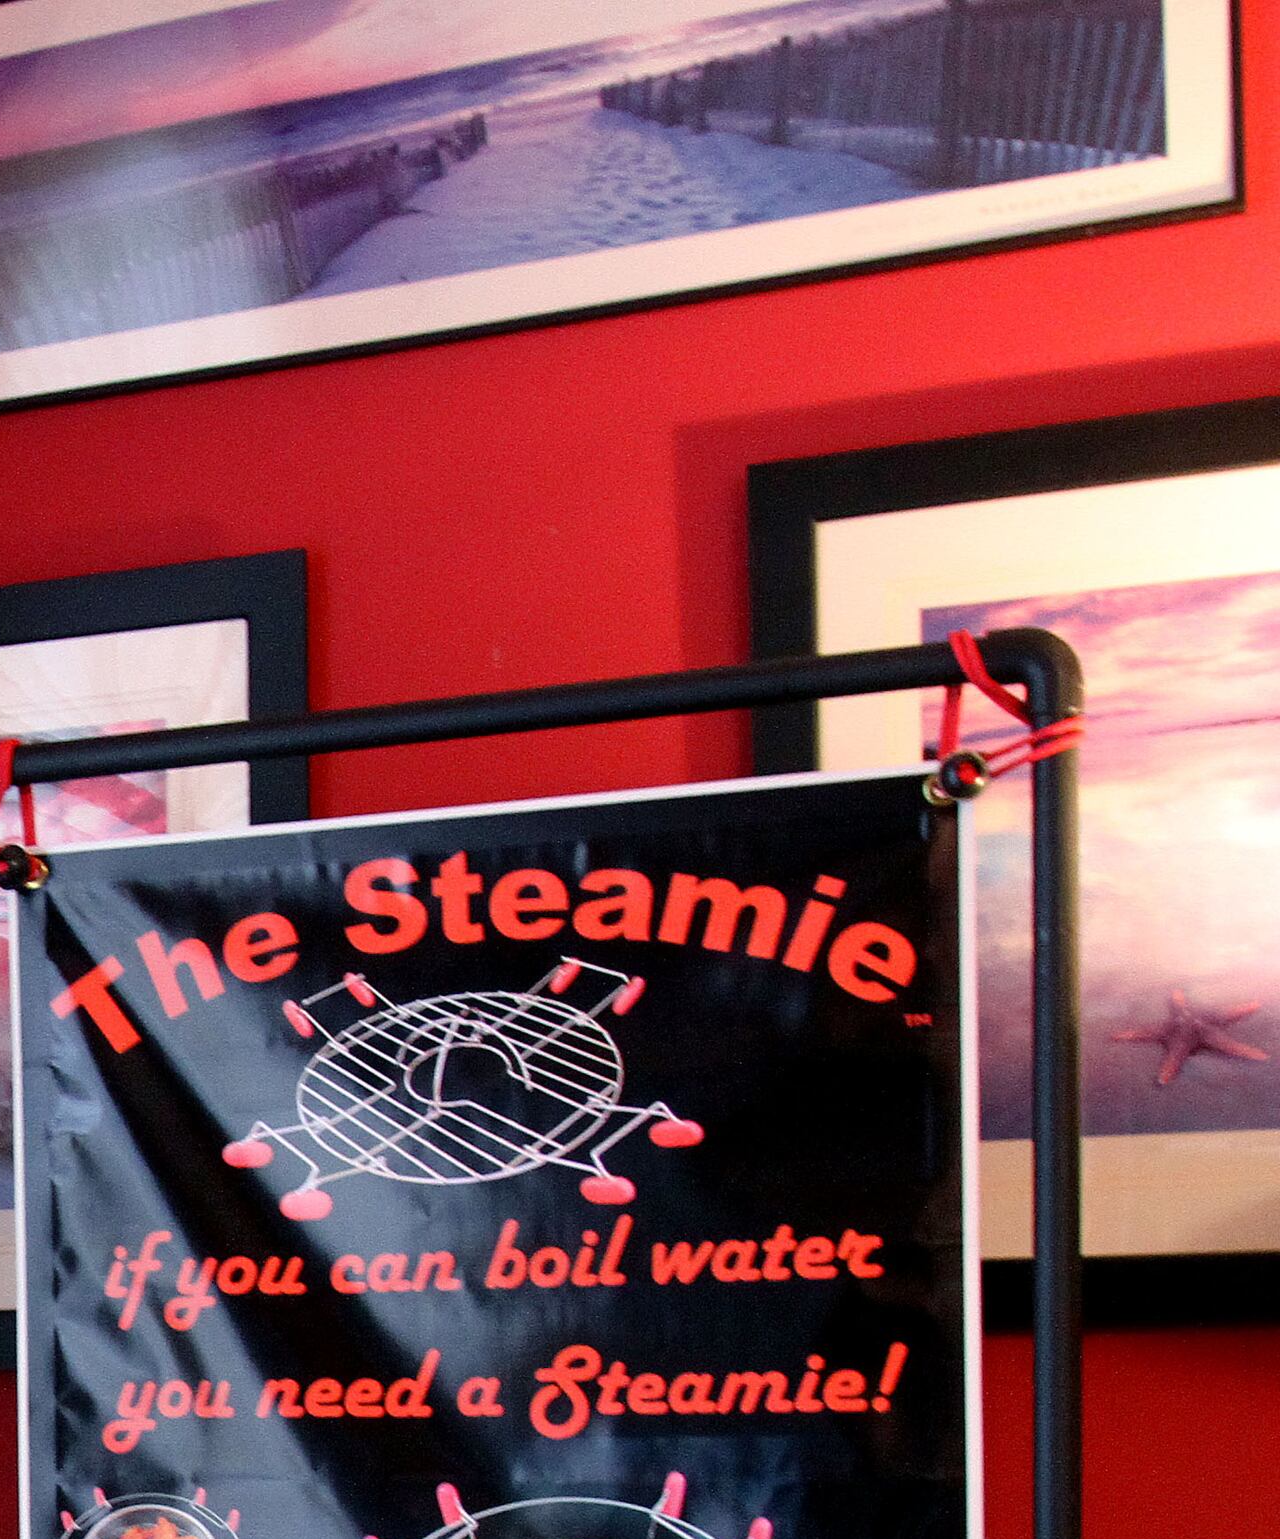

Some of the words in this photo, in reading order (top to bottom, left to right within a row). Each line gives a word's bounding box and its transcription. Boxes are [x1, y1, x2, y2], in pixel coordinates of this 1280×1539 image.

[49, 909, 301, 1056] The
[343, 849, 918, 1003] Steamie
[103, 1230, 172, 1332] if
[162, 1252, 306, 1332] you
[329, 1253, 461, 1294] can
[484, 1213, 634, 1295] boil
[649, 1223, 885, 1287] water
[101, 1373, 235, 1455] you
[255, 1346, 443, 1419] need
[455, 1376, 504, 1418] a
[528, 1341, 911, 1441] Steamie!
